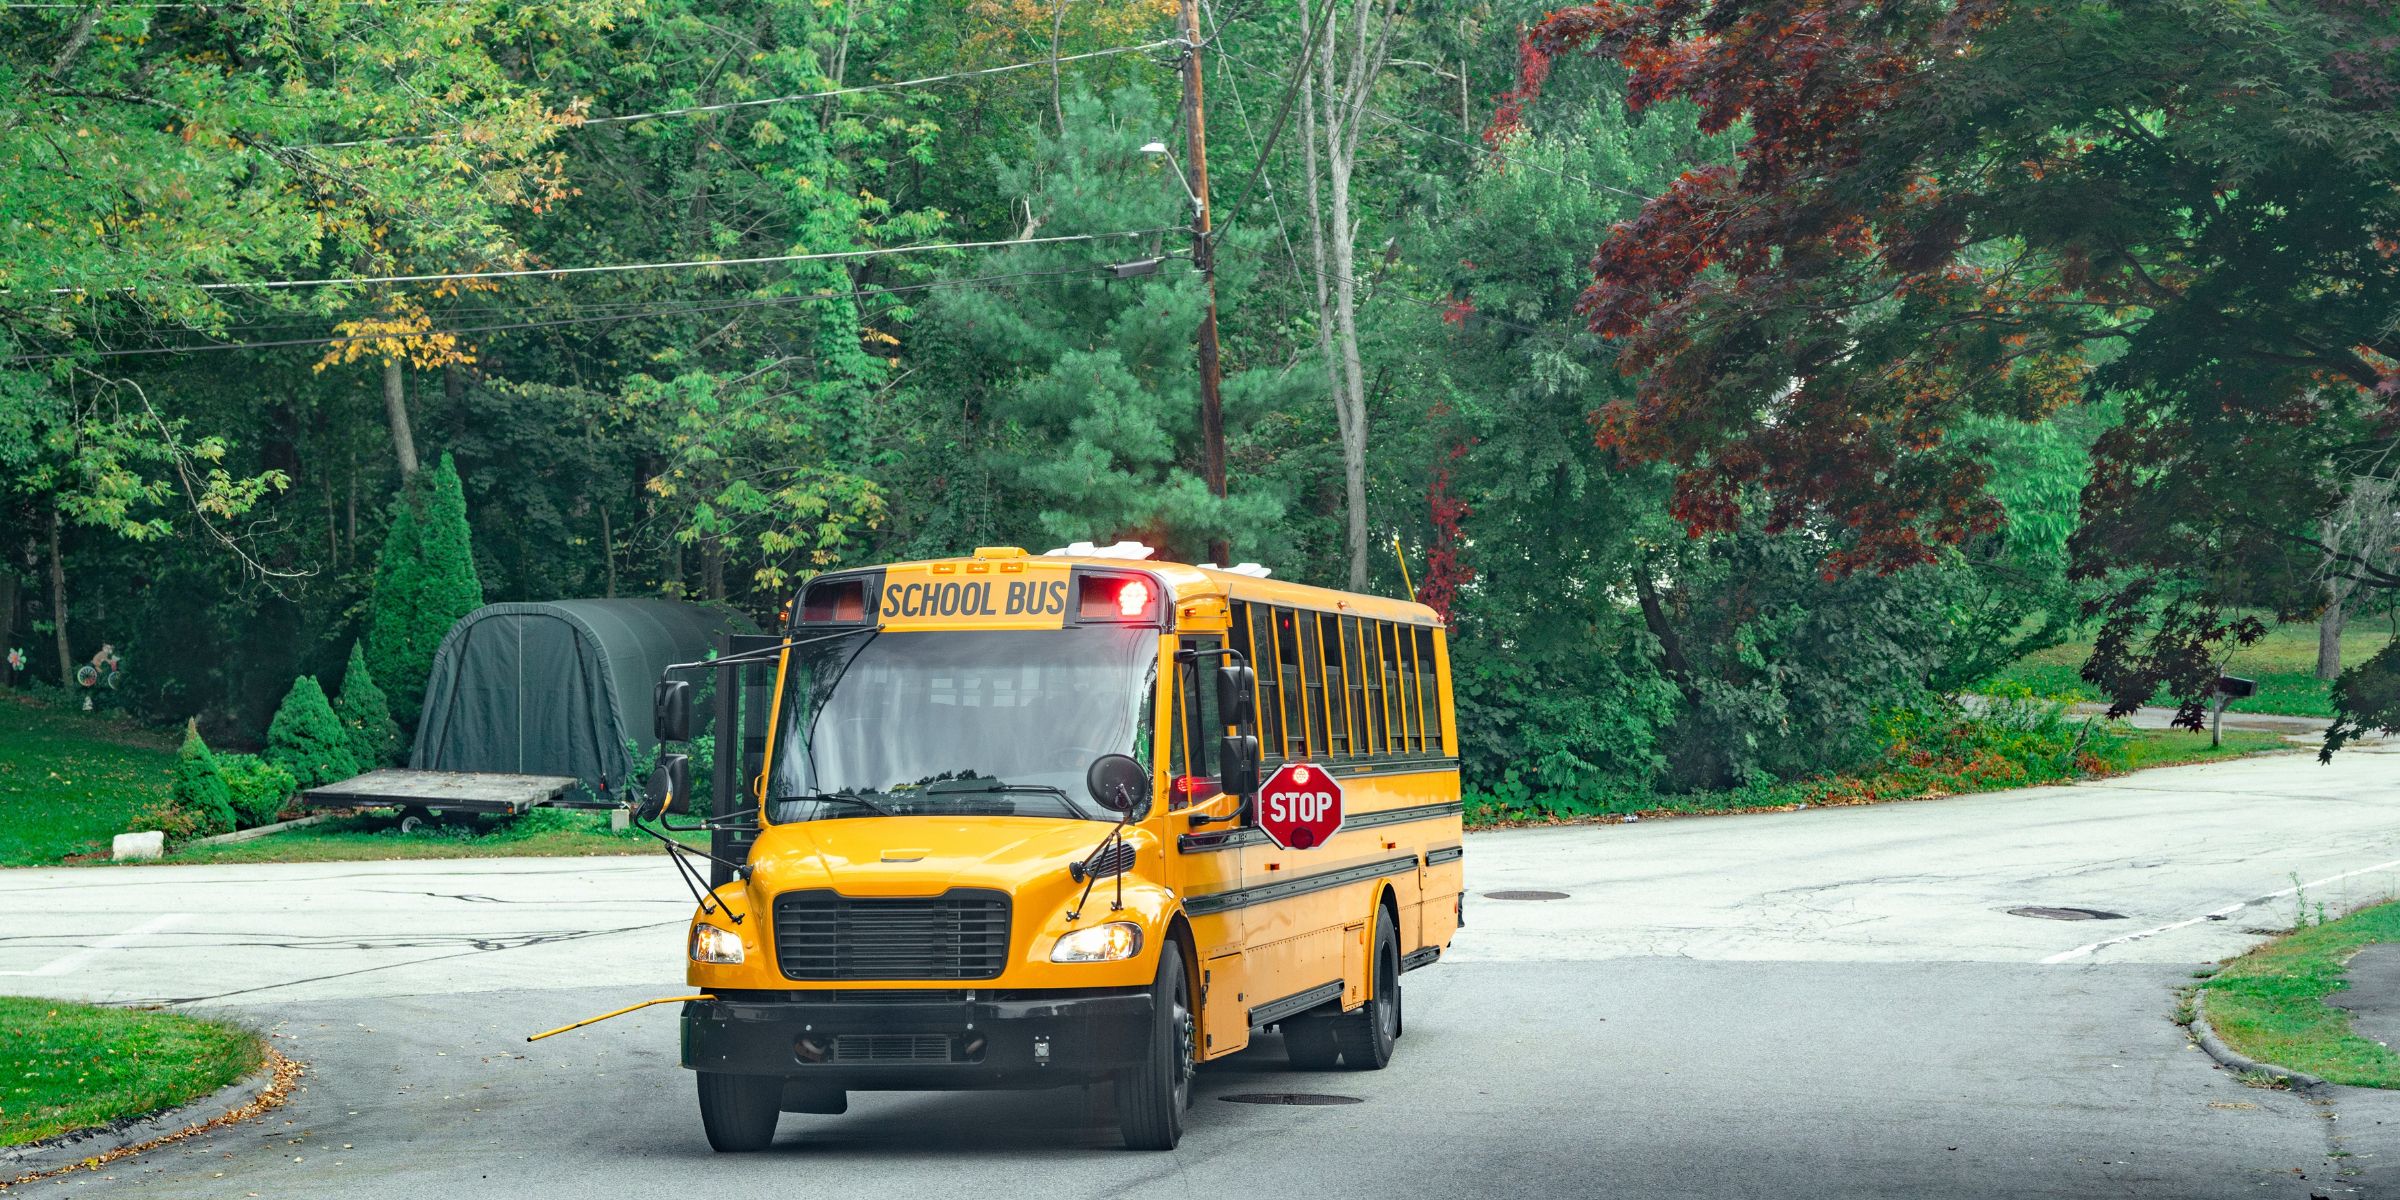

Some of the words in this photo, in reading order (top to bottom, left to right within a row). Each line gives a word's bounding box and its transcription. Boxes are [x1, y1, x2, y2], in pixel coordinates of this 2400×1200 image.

[883, 582, 996, 617] SCHOOL
[1005, 581, 1066, 615] BUS
[1271, 792, 1332, 822] STOP
